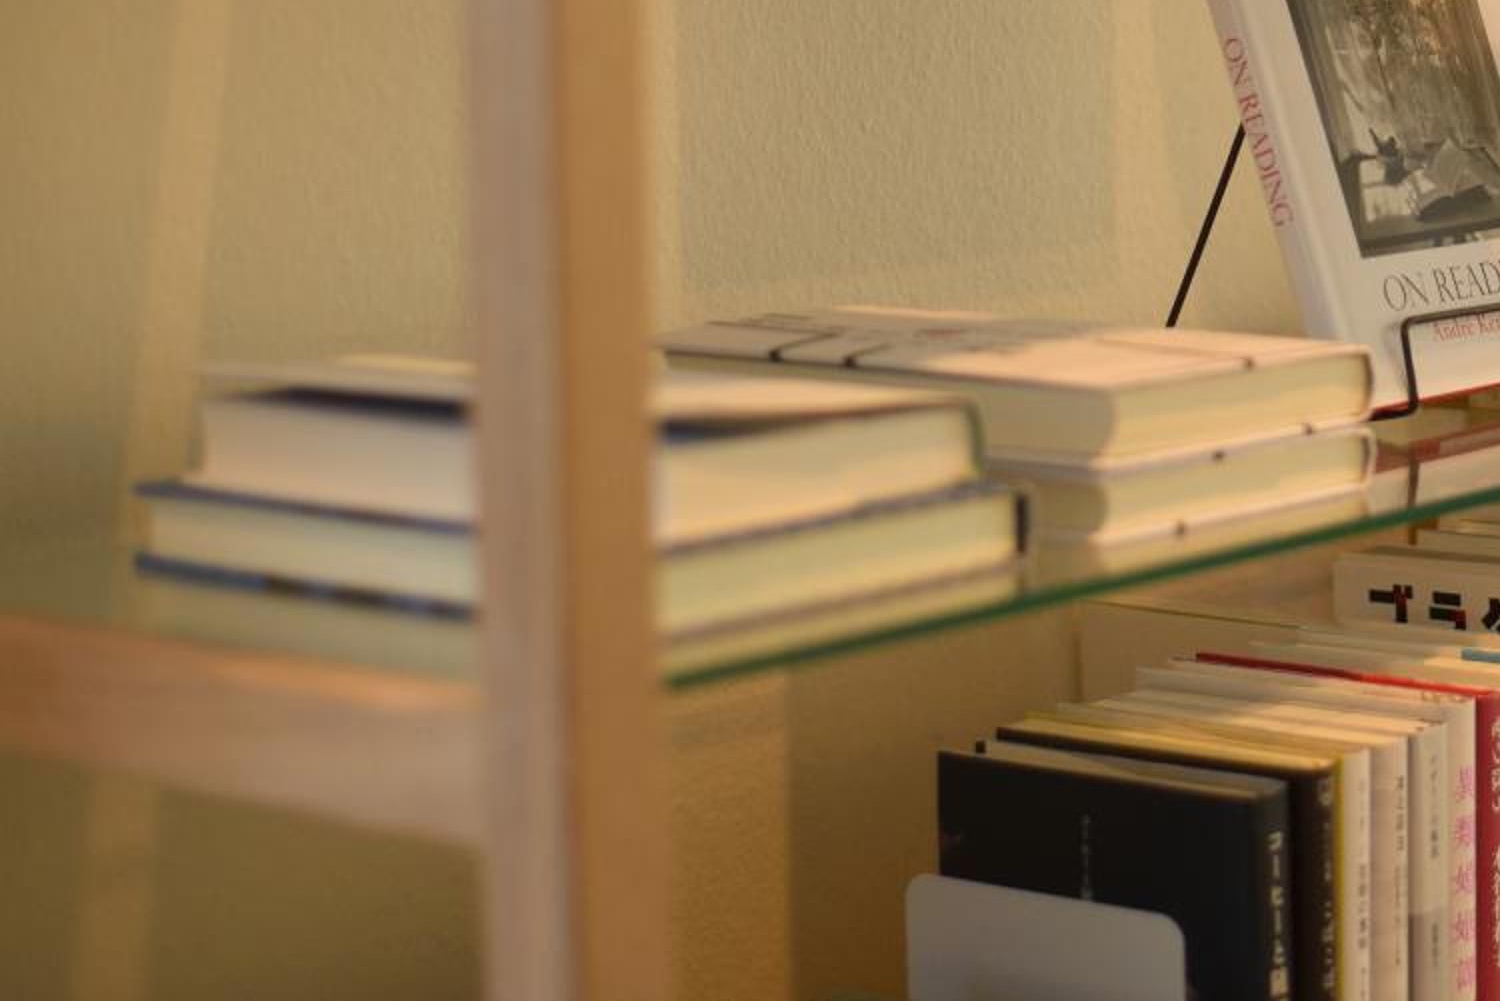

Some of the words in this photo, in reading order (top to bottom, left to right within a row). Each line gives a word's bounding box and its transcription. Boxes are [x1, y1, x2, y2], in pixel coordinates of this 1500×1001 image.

[1224, 37, 1252, 87] ON
[1238, 94, 1294, 228] READING
[1383, 270, 1430, 312] ON
